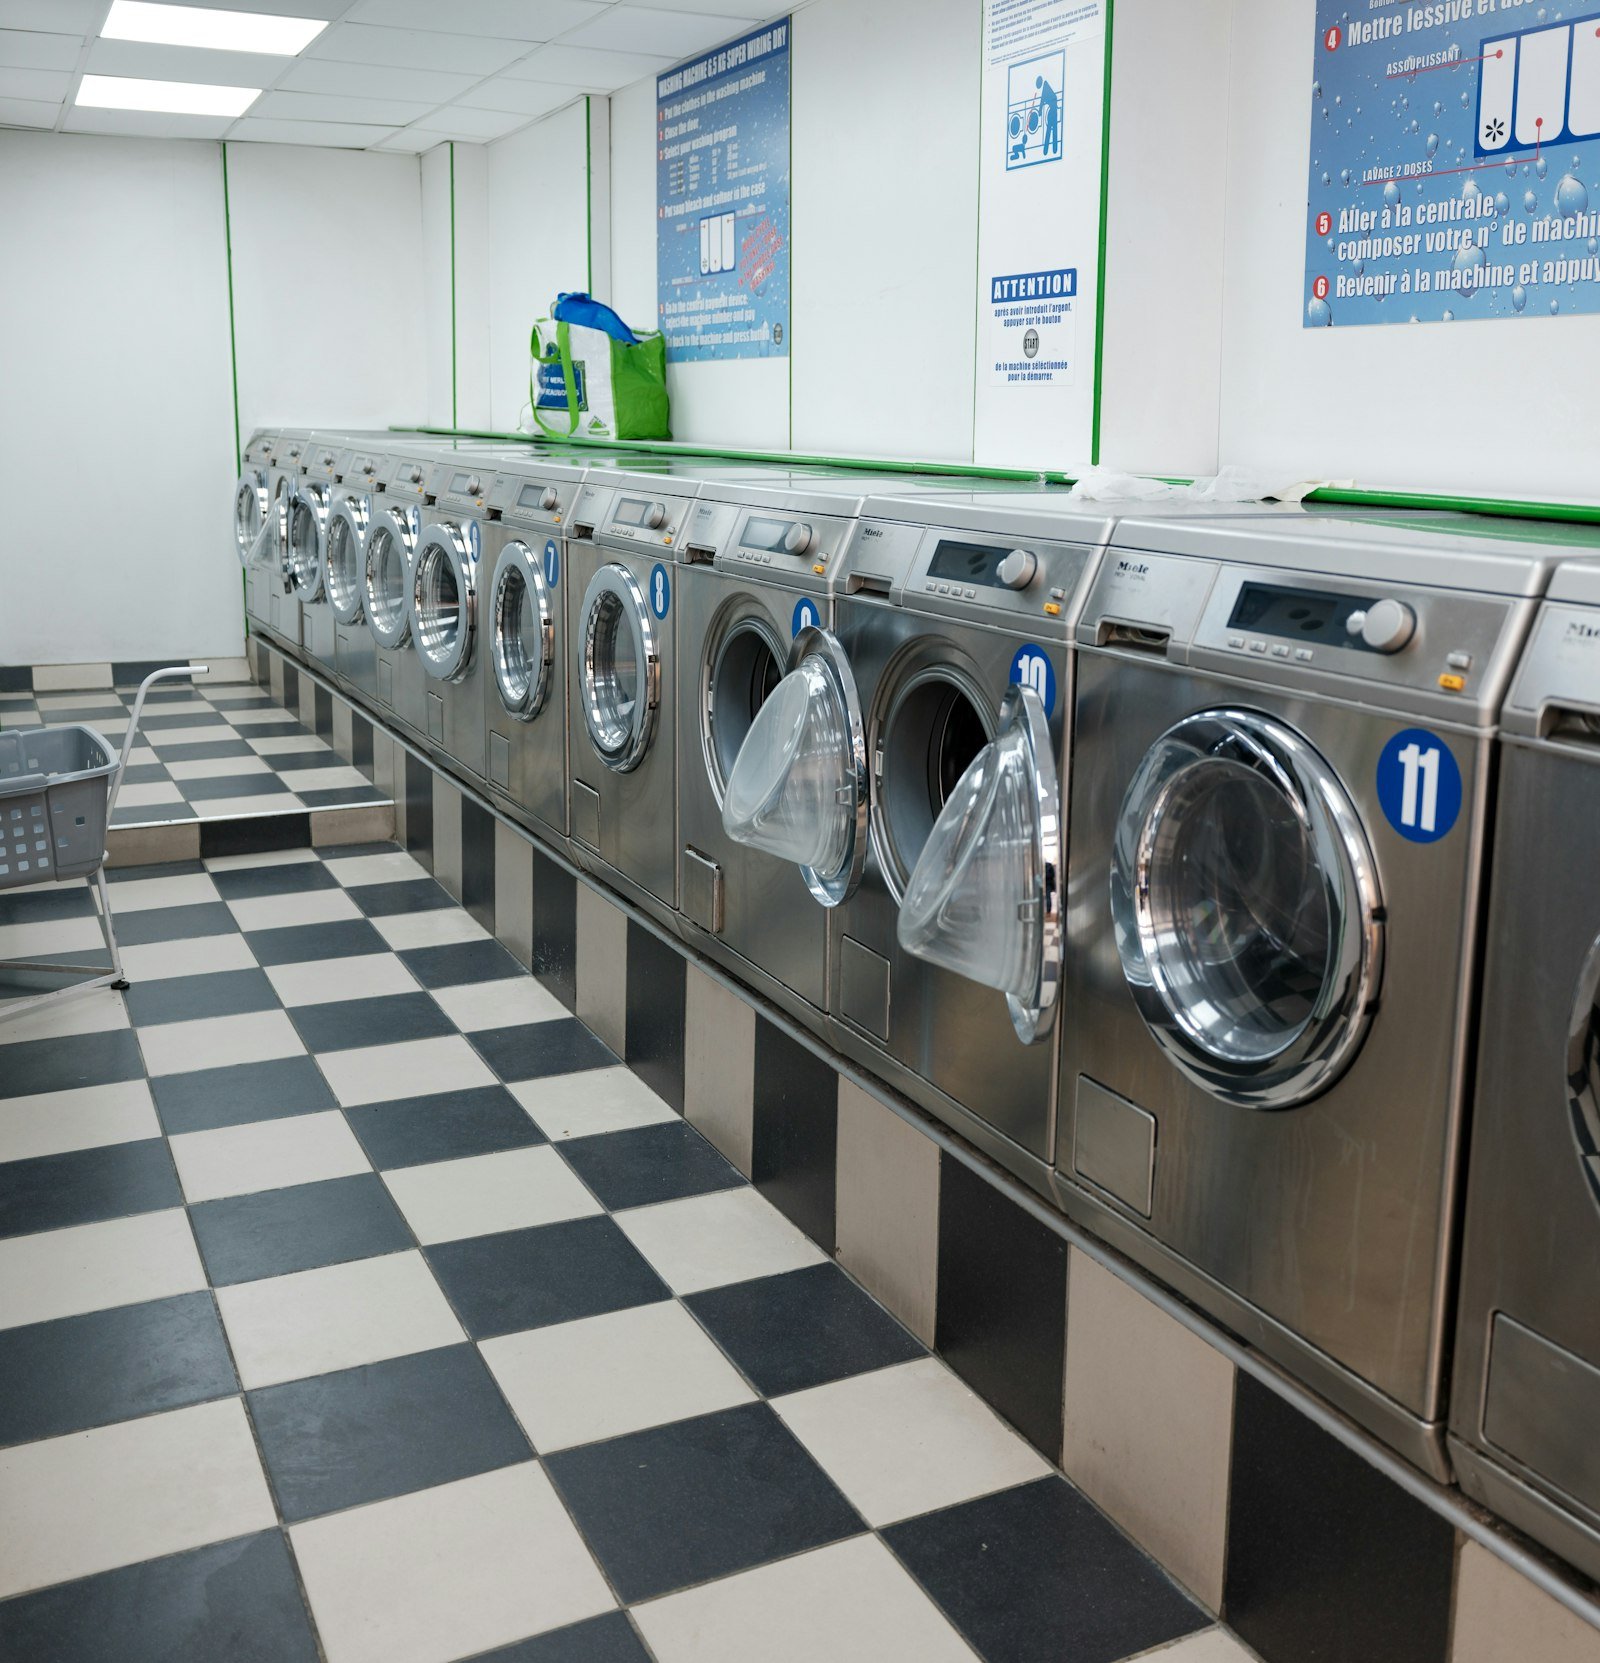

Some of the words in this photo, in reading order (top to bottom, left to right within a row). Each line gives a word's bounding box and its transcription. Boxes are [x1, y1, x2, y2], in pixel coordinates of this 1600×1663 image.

[1328, 30, 1336, 48] 4
[1348, 15, 1402, 46] Mettre
[1407, 0, 1472, 32] lessive
[683, 61, 708, 88] MACHINE
[727, 43, 747, 69] SUPER
[773, 25, 786, 49] DRY
[1386, 48, 1460, 75] ASSOUPLISSANT
[707, 90, 715, 104] the
[740, 71, 766, 91] machine
[1363, 166, 1393, 181] LAVAGE
[1396, 165, 1401, 176] 2
[1404, 160, 1432, 175] DOSES
[740, 185, 750, 199] the
[751, 182, 766, 196] case
[1320, 215, 1328, 233] 5
[1339, 209, 1377, 233] Aller
[1381, 204, 1391, 229] à
[1395, 204, 1411, 227] la
[1416, 193, 1498, 225] centrale,
[1338, 234, 1421, 261] composer
[1426, 228, 1472, 253] votre
[1477, 222, 1498, 248] n°
[1502, 220, 1526, 245] de
[1531, 211, 1600, 242] machi
[994, 273, 1072, 299] ATTENTION
[1317, 279, 1326, 296] 6
[1336, 271, 1397, 298] Revenir
[1401, 269, 1410, 293] à
[1414, 268, 1430, 292] la
[1435, 263, 1514, 290] machine
[1520, 260, 1538, 285] et
[994, 308, 1009, 317] après
[1010, 307, 1023, 315] avoir
[1024, 304, 1048, 315] introduit
[1049, 302, 1072, 313] l'argent,
[1003, 318, 1025, 327] appuyer
[1035, 316, 1041, 324] le
[1042, 315, 1061, 324] bouton
[734, 331, 750, 344] press
[1024, 338, 1038, 349] START
[995, 363, 1001, 371] de
[1002, 362, 1007, 370] la
[1009, 362, 1031, 370] machine
[1008, 373, 1020, 381] pour
[1027, 372, 1053, 381] démarrer.
[863, 527, 884, 538] Miele
[547, 547, 554, 582] 7
[1117, 561, 1149, 574] Miele
[655, 571, 664, 614] 8
[1398, 743, 1440, 832] 11
